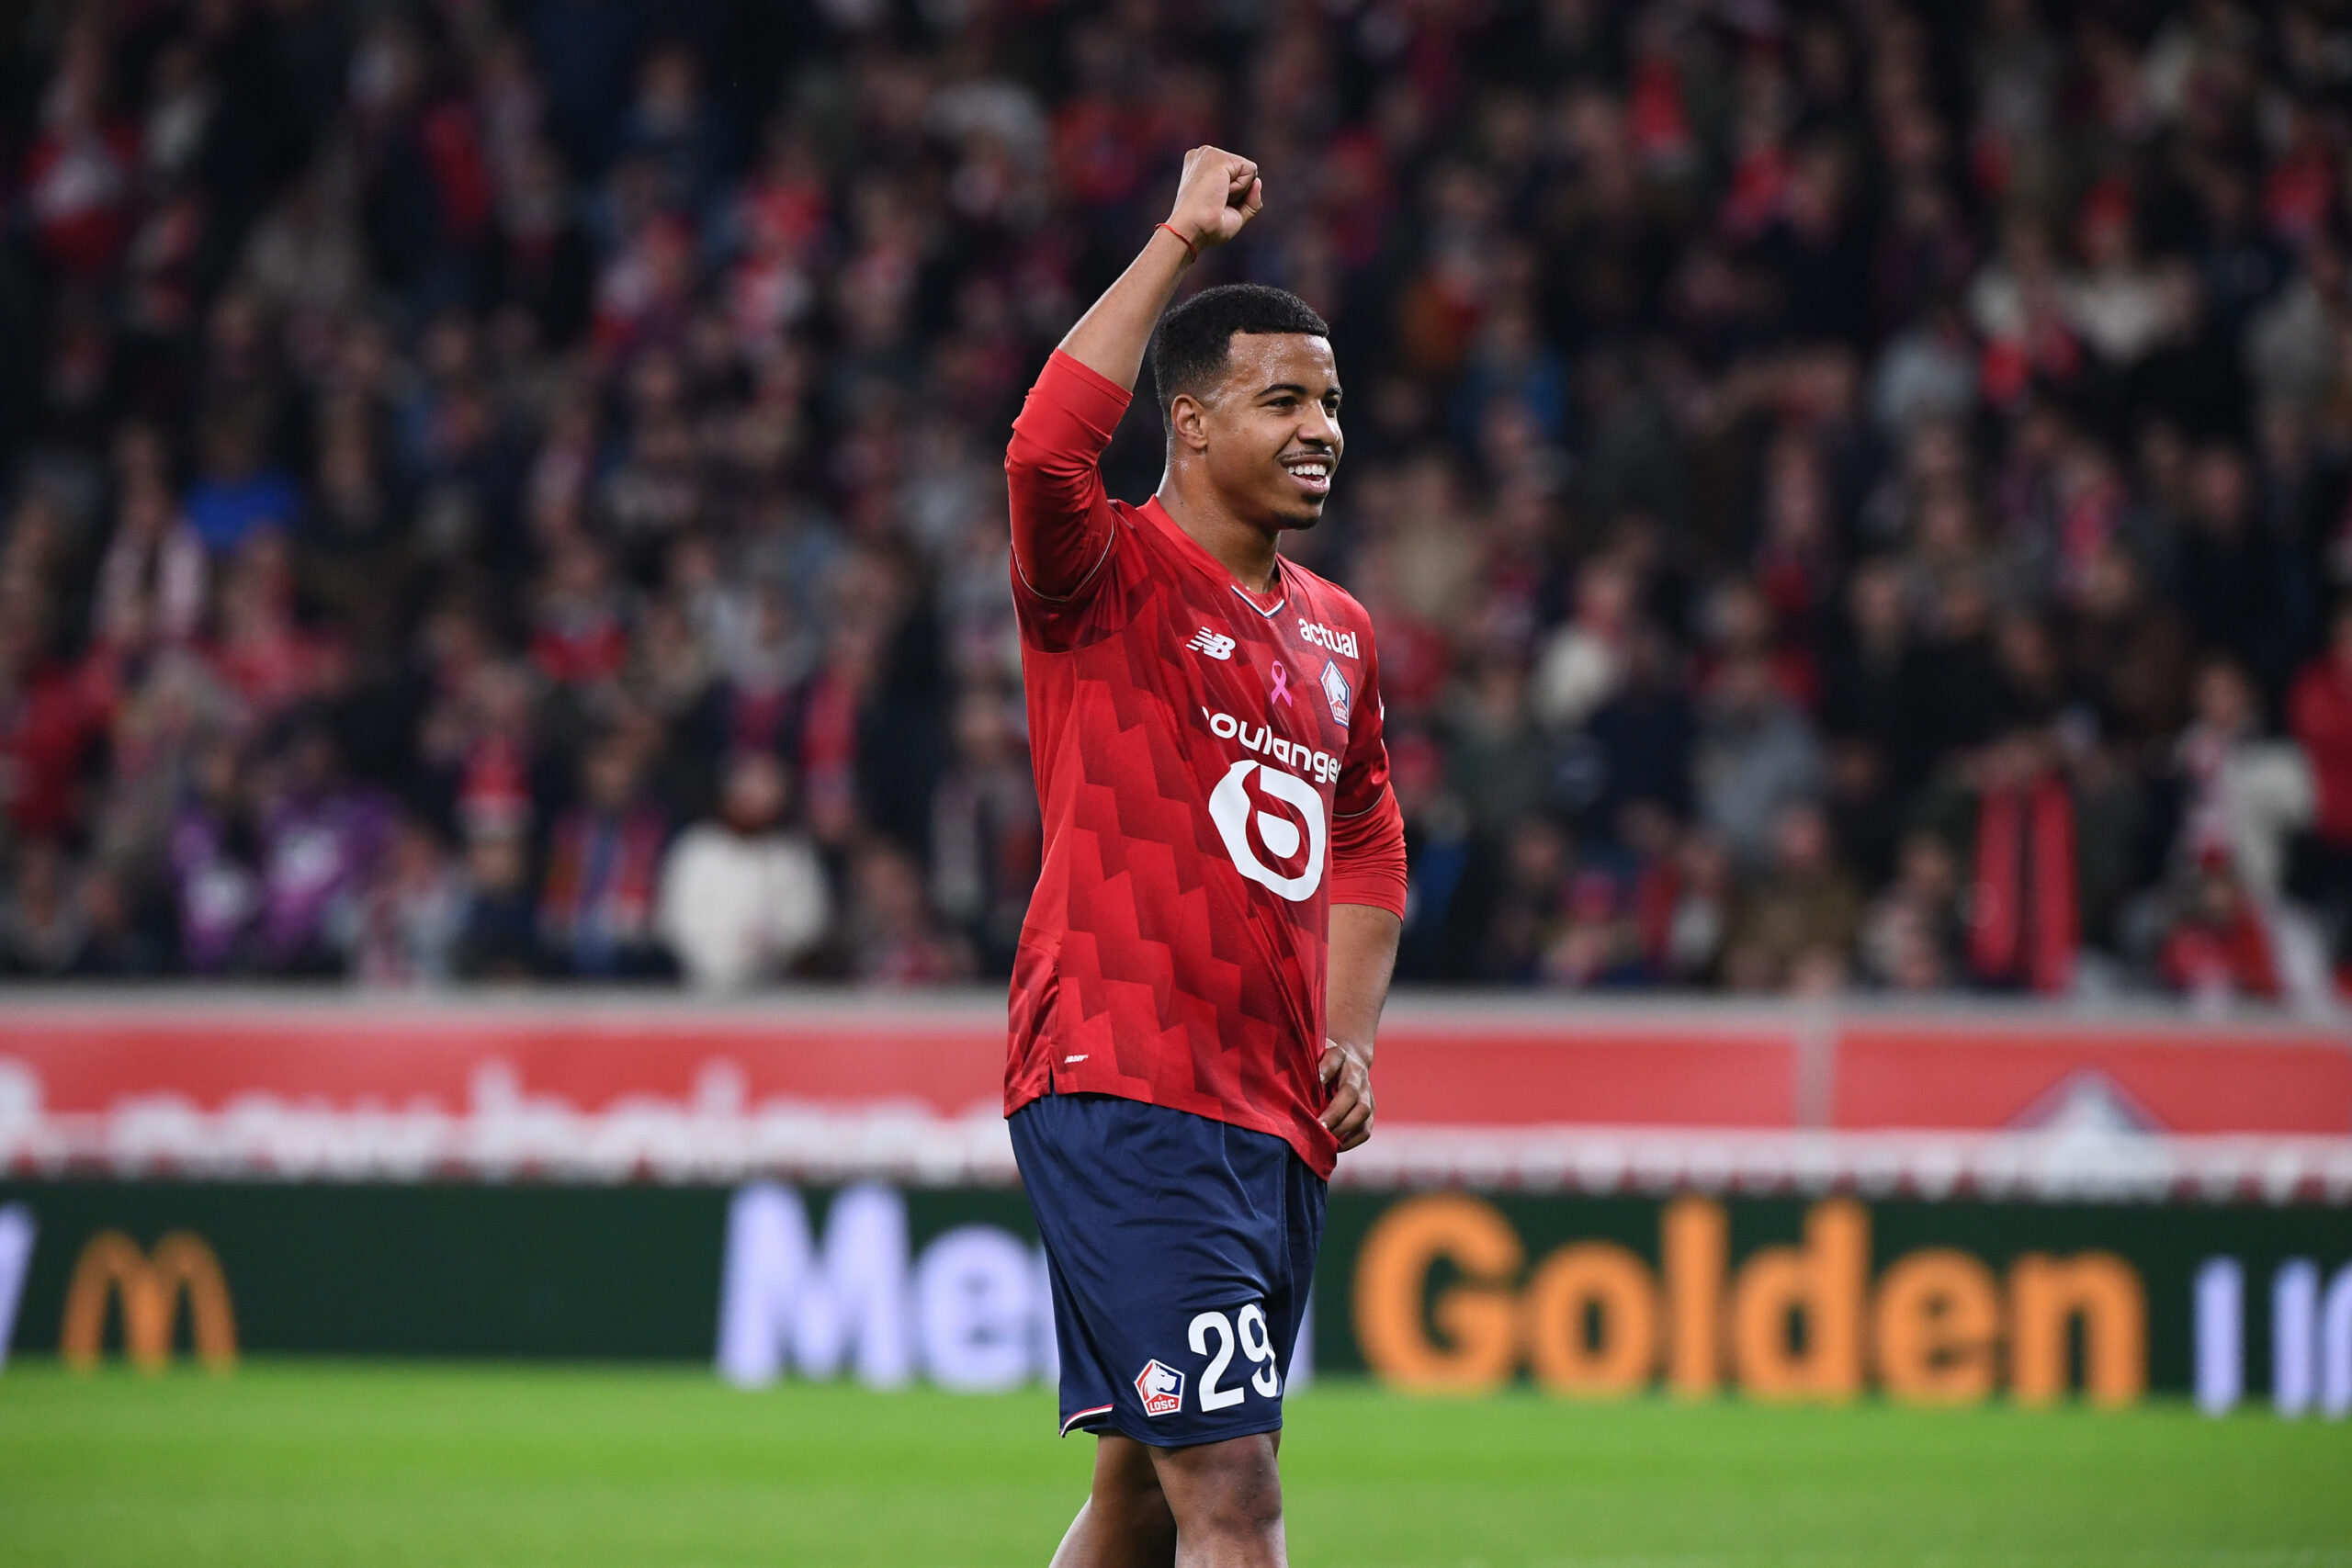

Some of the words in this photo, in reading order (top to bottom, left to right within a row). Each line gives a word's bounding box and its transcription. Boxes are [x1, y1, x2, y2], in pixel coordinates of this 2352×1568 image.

[1298, 617, 1359, 660] actual
[1202, 705, 1342, 784] oulange
[1354, 1192, 2148, 1410] Golden
[1188, 1303, 1278, 1413] 29
[1148, 1398, 1176, 1412] LOSC
